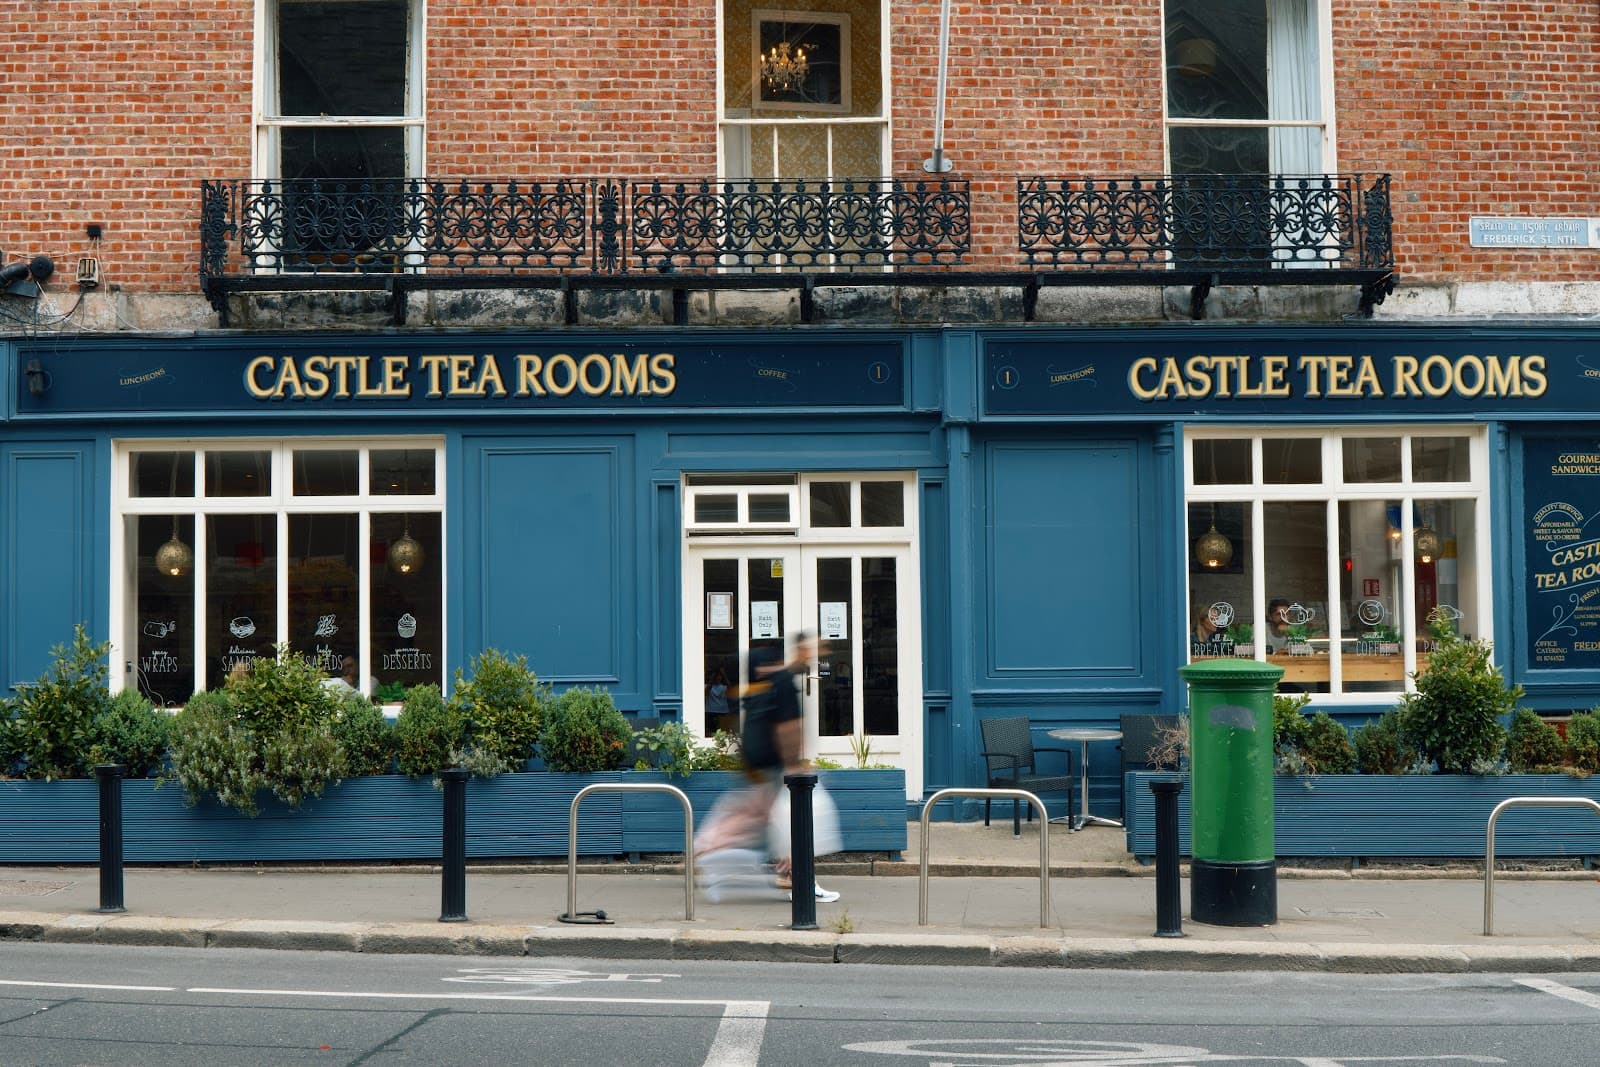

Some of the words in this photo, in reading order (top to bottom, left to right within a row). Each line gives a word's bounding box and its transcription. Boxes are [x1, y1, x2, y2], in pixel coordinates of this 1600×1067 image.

[1483, 234, 1536, 244] FREDERICK
[1557, 235, 1577, 245] NTH
[120, 367, 166, 386] LUNCHEONS
[246, 355, 411, 398] CASTLE
[420, 354, 507, 397] TEA
[517, 353, 677, 396] ROOMS
[758, 369, 787, 379] COFFEE
[1050, 366, 1095, 383] LUNCHEONS
[1129, 355, 1290, 398] CASTLE
[1299, 355, 1384, 397] TEA
[1393, 355, 1548, 398] ROOMS
[1534, 571, 1568, 588] TEA
[1356, 640, 1391, 657] COFFEE
[142, 656, 178, 673] WRAPS
[383, 653, 432, 670] DESSERTS
